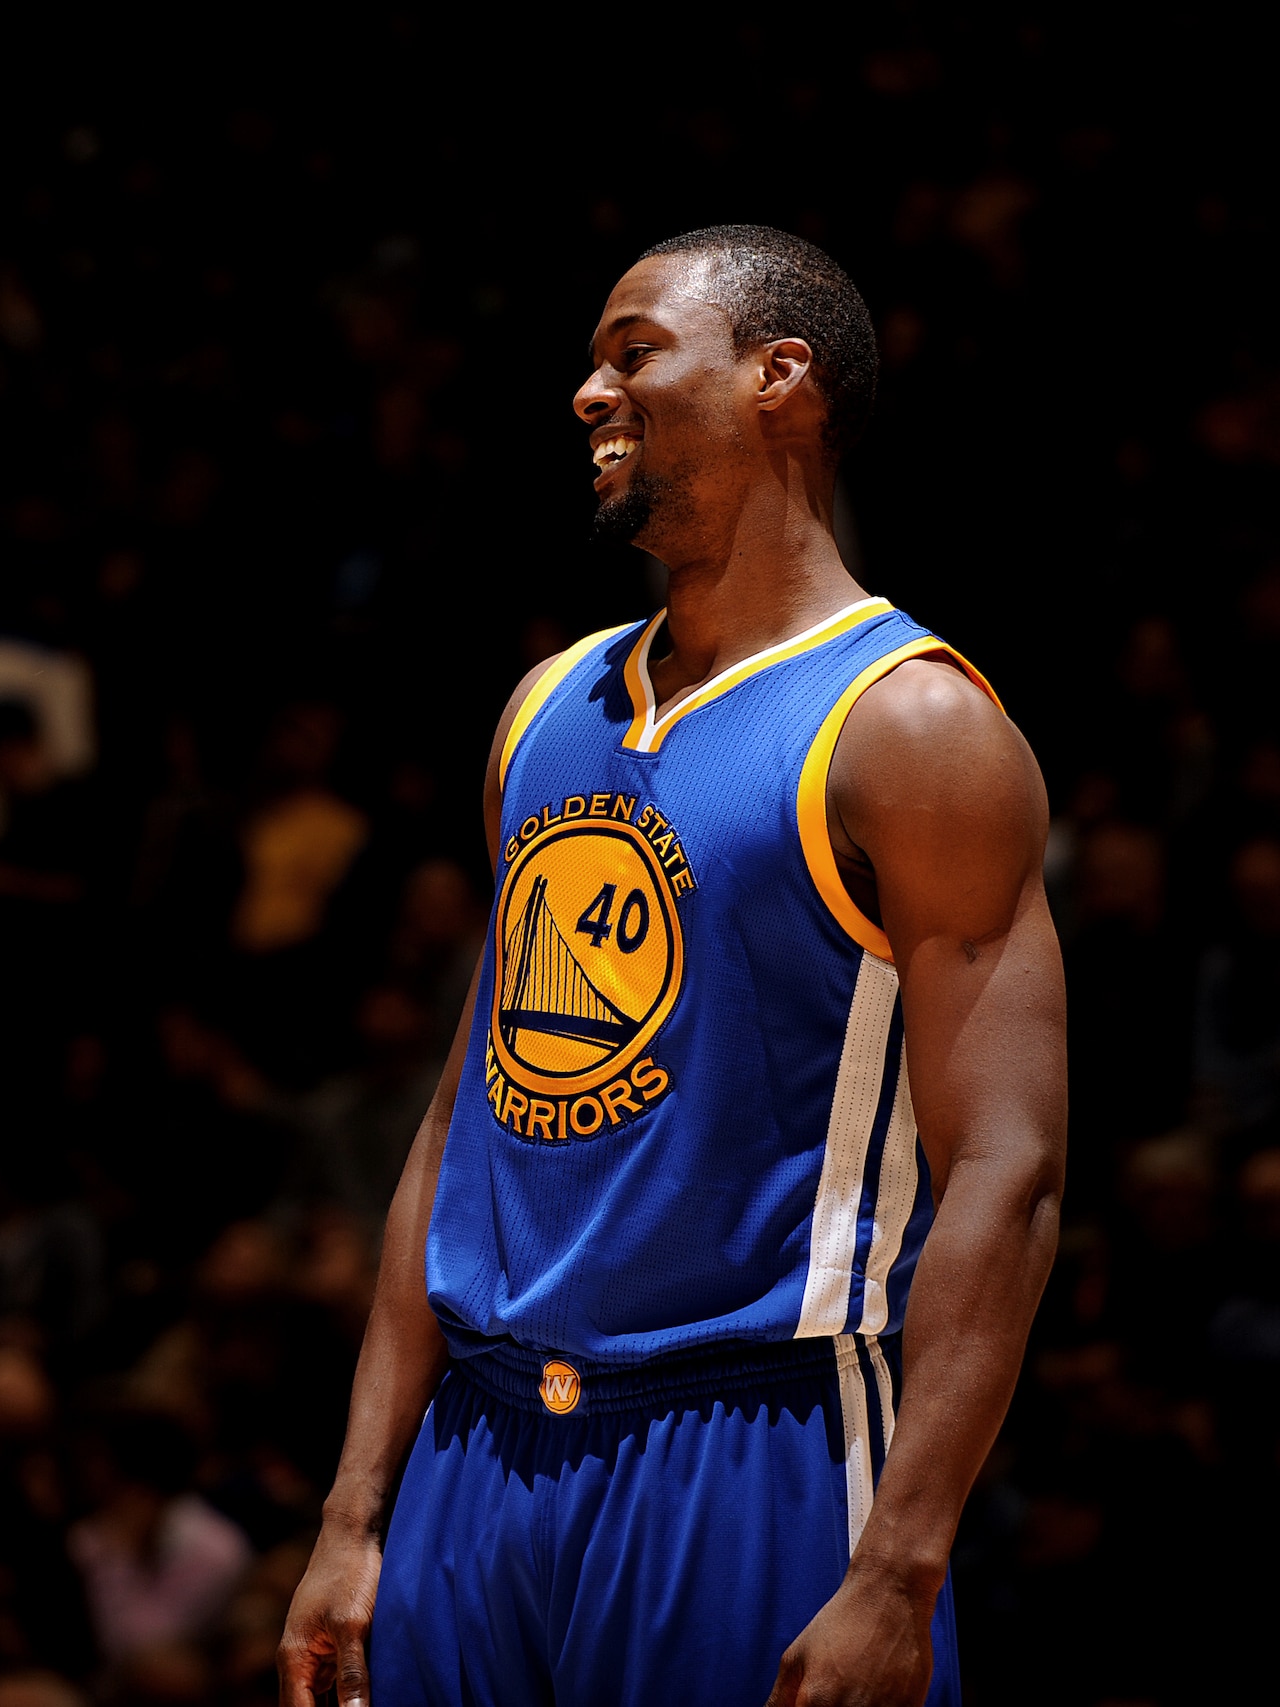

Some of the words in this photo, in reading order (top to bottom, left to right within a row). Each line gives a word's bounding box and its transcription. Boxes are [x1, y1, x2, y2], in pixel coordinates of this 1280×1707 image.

[504, 793, 636, 864] GOLDEN
[637, 806, 695, 897] STATE
[574, 883, 650, 955] 40
[545, 1374, 576, 1403] W
